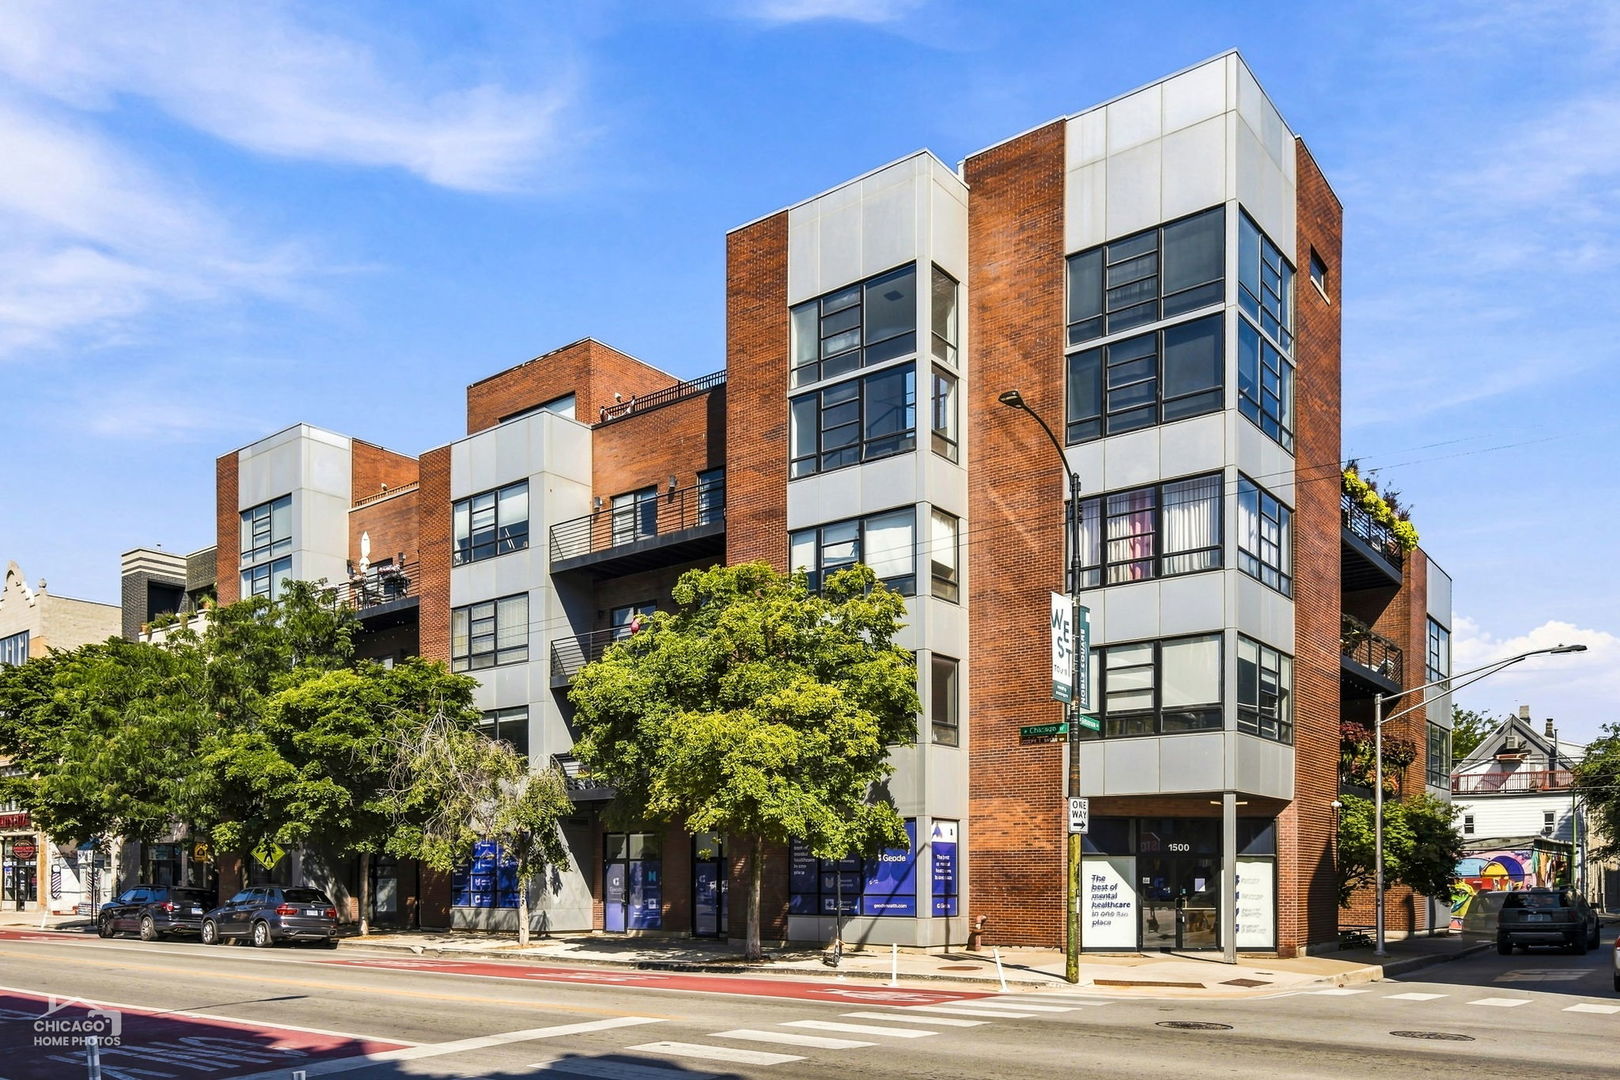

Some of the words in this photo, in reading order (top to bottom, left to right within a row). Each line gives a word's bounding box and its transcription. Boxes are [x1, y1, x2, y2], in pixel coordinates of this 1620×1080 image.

[1072, 800, 1087, 810] ONE
[1072, 810, 1087, 819] WAY
[1168, 843, 1190, 852] 1500
[882, 853, 906, 862] Geode
[1091, 874, 1106, 883] The
[1109, 883, 1118, 891] of
[1091, 901, 1131, 909] healthcare
[1091, 919, 1112, 928] place
